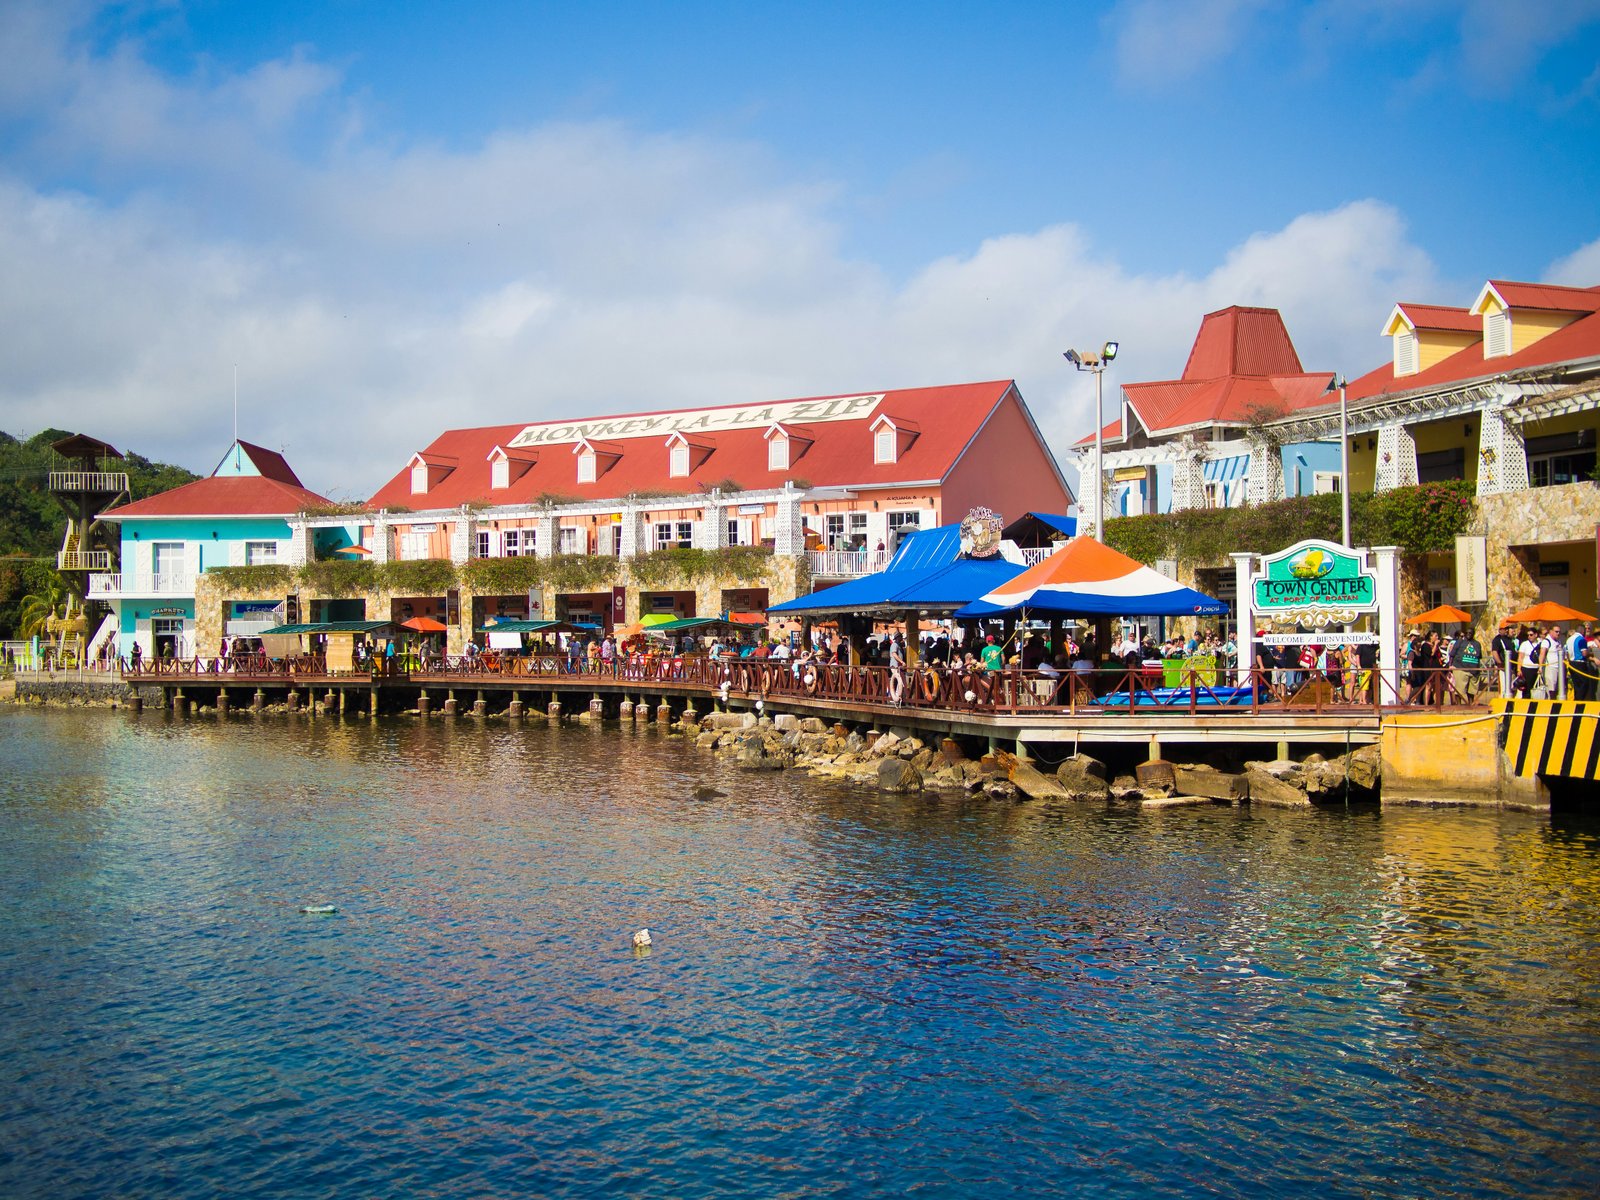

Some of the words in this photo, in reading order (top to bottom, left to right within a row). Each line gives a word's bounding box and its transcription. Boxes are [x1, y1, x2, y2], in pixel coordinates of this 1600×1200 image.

[513, 415, 671, 445] MONKEY
[667, 407, 774, 431] LA-LA
[779, 396, 877, 421] ZIP
[1262, 579, 1307, 597] TOWN
[1310, 578, 1369, 596] CENTER
[1202, 605, 1220, 613] pepsi
[1264, 636, 1305, 644] WELCOME
[1316, 635, 1373, 643] BIENVENIDOS
